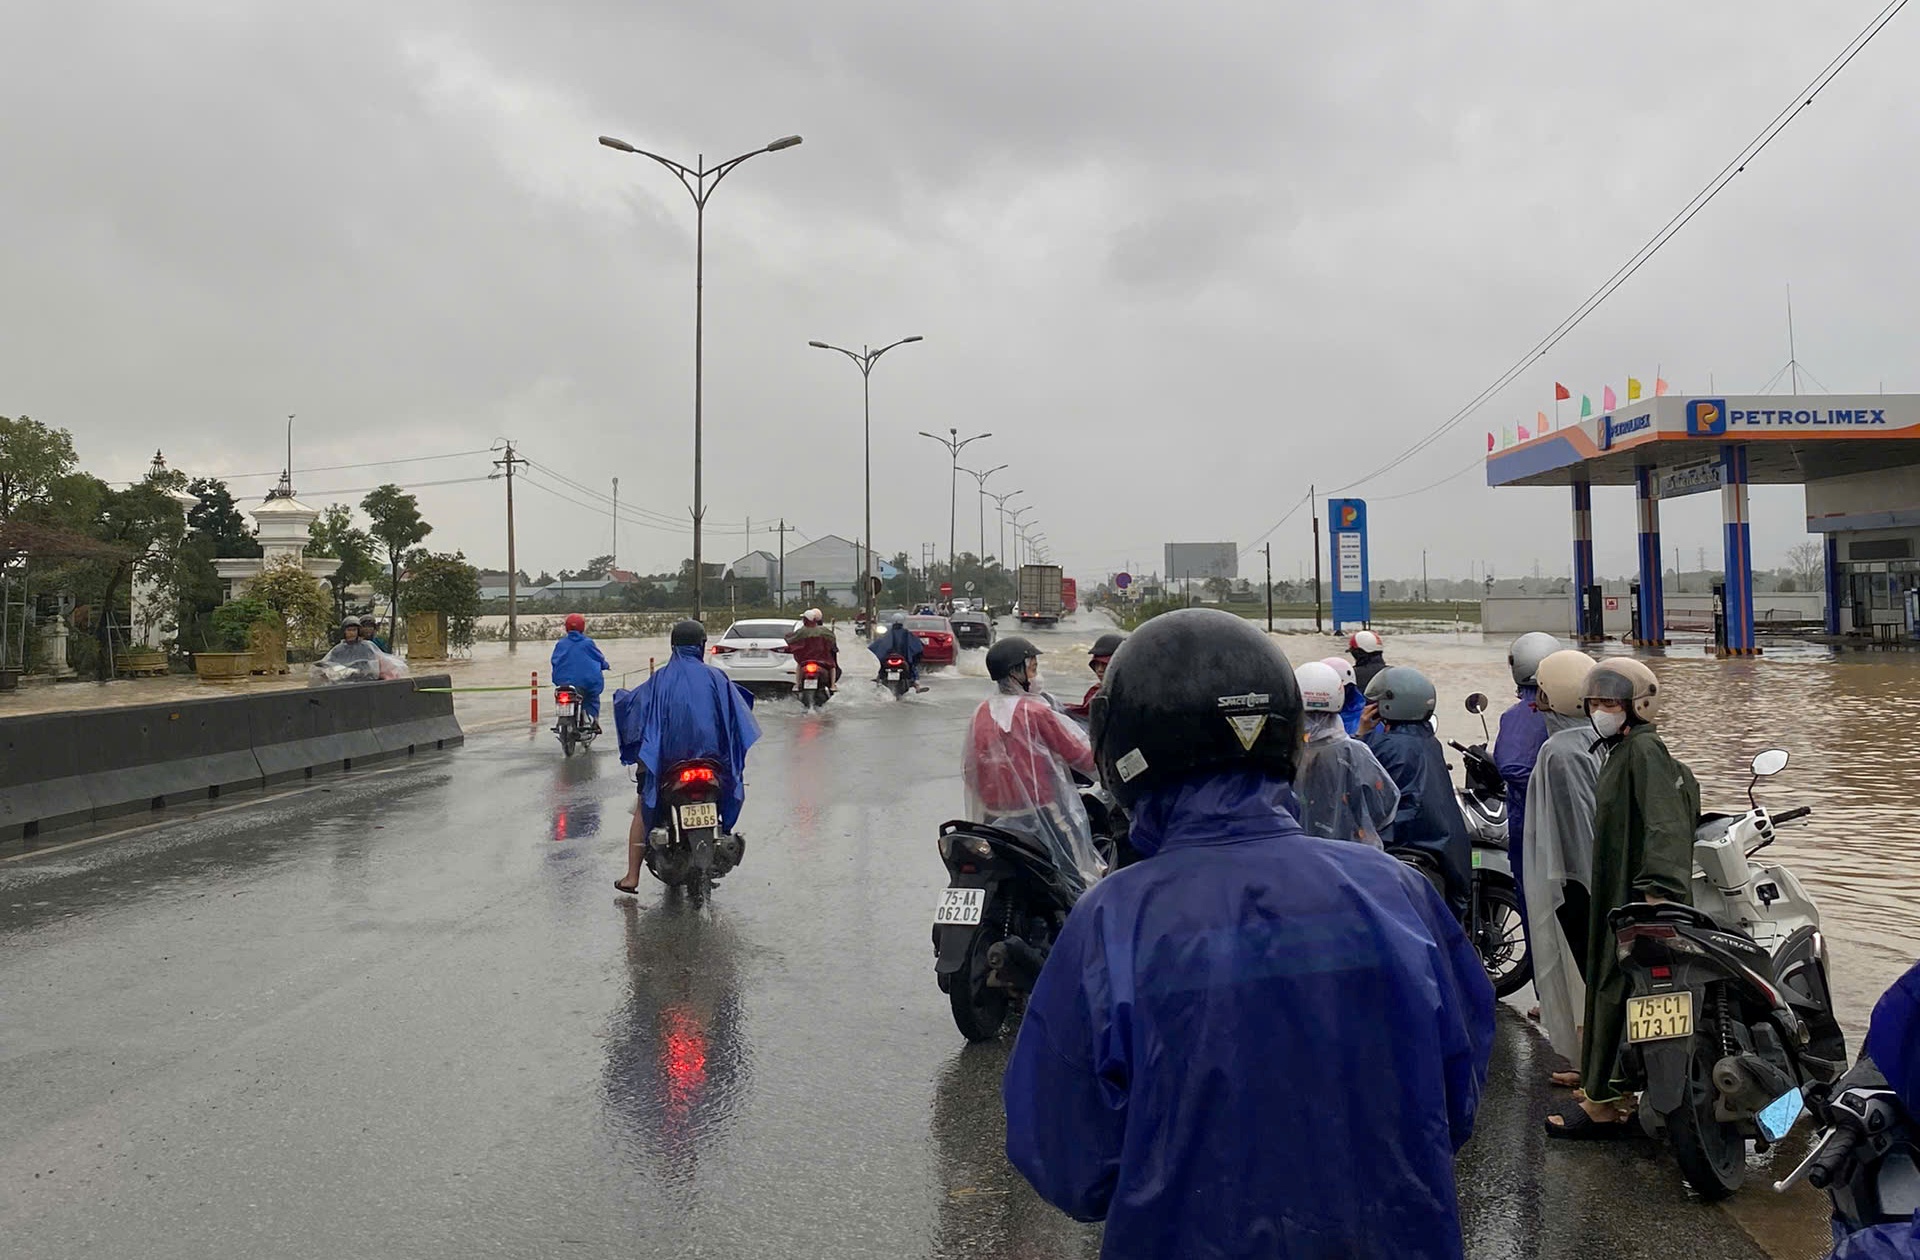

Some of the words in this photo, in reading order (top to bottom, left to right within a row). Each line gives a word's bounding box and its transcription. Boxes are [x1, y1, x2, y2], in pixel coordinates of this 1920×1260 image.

[1730, 410, 1886, 425] PETROLIMEX
[945, 891, 976, 906] 75-AA
[937, 906, 979, 921] 062.02
[1637, 996, 1680, 1017] 75-C1
[1632, 1015, 1688, 1038] 173.17
